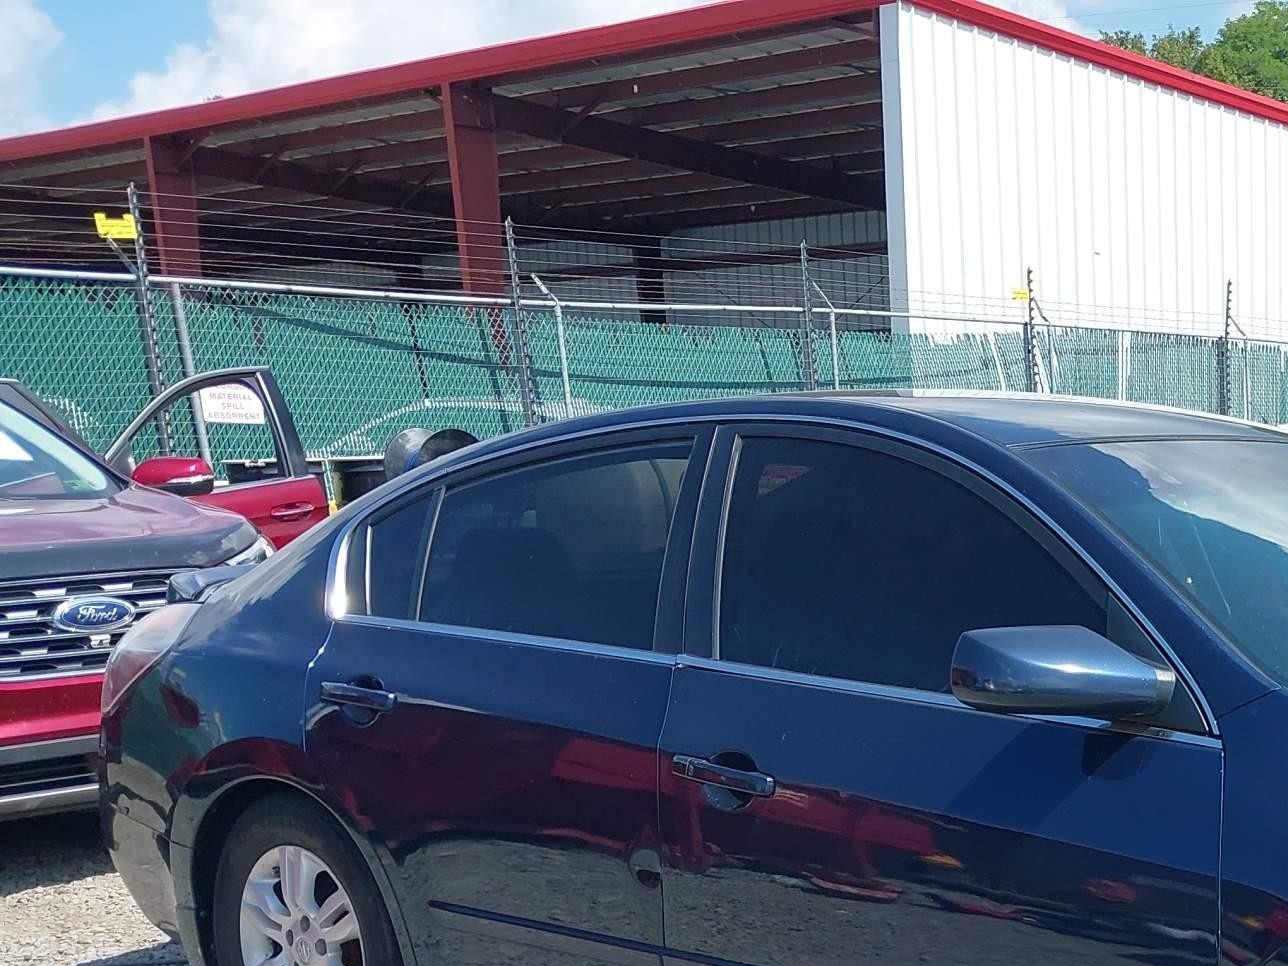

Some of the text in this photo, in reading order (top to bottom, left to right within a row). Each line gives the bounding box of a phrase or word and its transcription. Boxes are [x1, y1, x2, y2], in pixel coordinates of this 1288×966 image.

[209, 392, 253, 401] MATERIAL
[221, 402, 245, 410] SPILL
[207, 411, 261, 421] ABSORBENT
[77, 605, 118, 622] Ford
